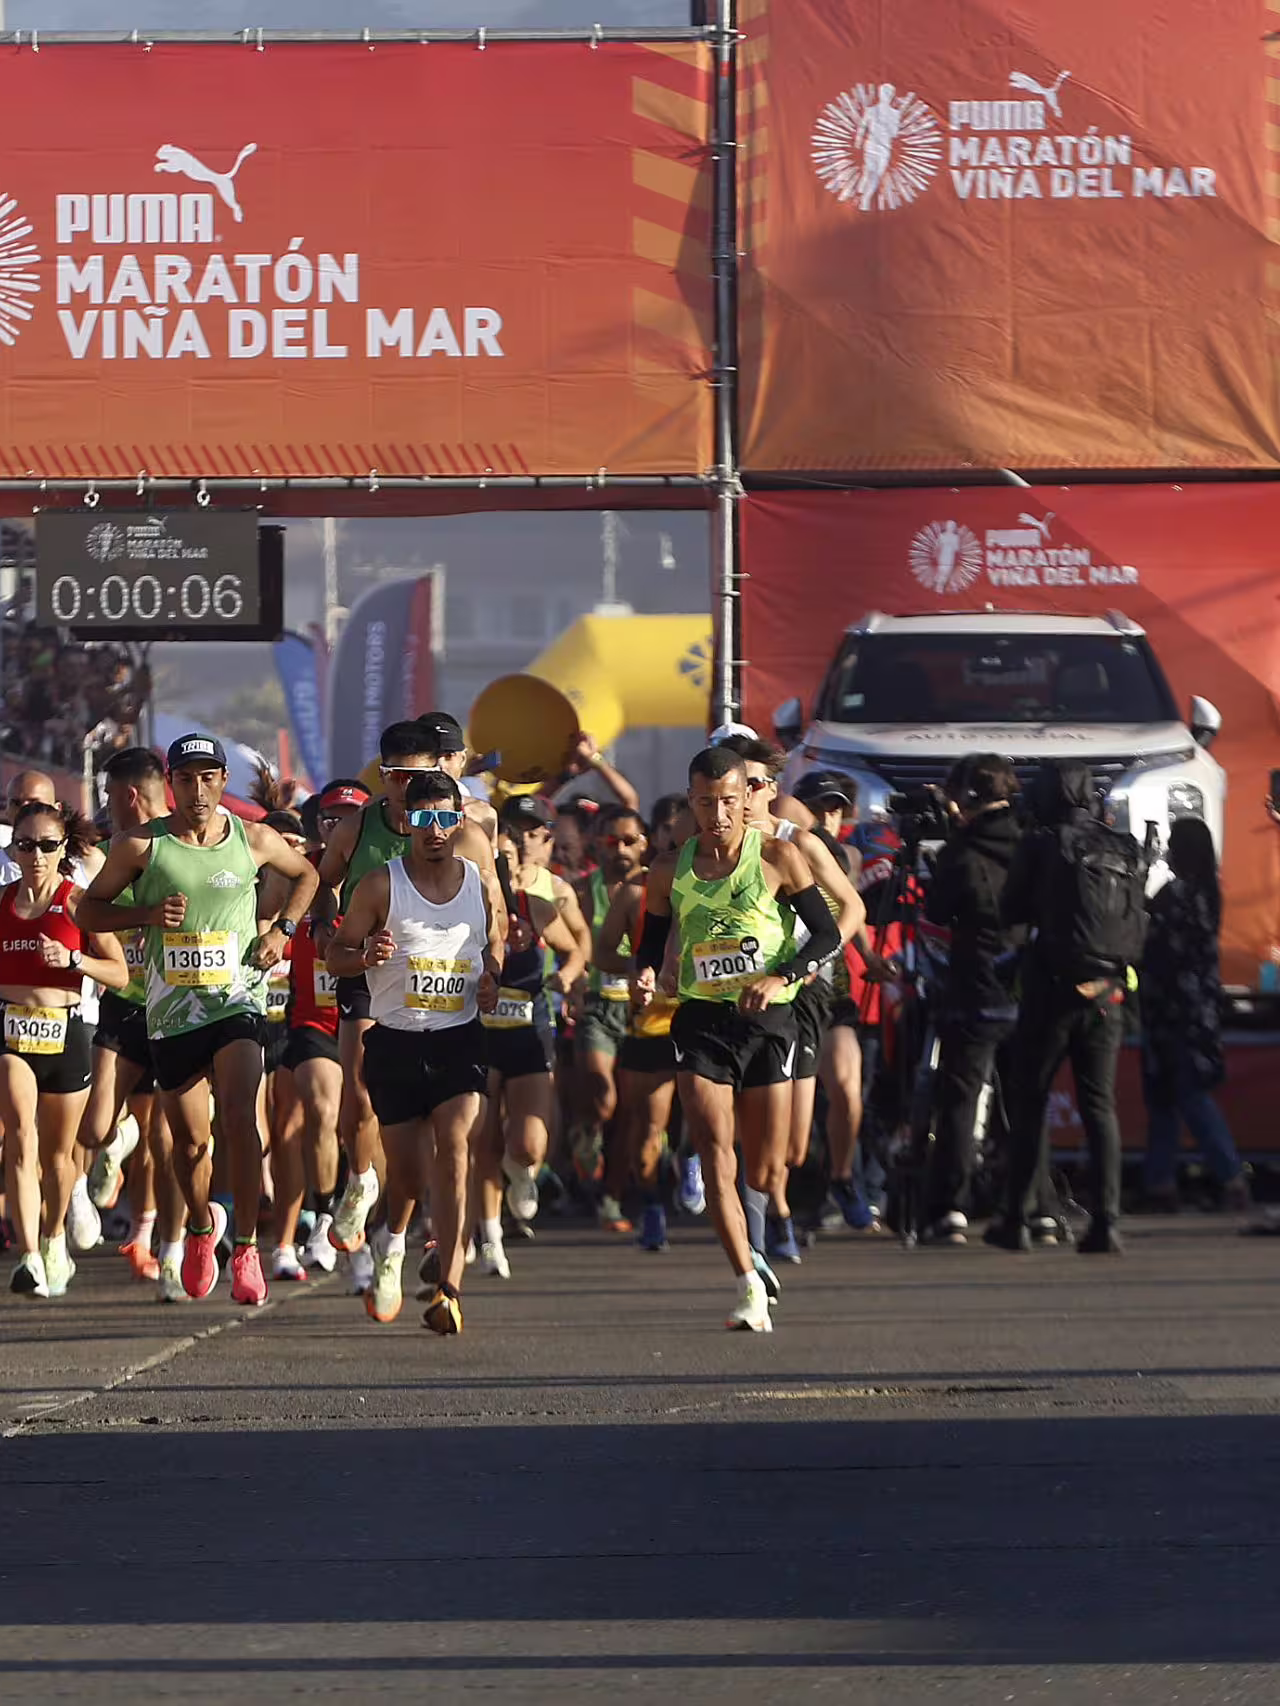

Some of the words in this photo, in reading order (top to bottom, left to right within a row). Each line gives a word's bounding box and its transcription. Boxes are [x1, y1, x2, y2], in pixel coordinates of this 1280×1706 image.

[949, 126, 1132, 167] MARATÓN
[951, 166, 1042, 200] VIÑA
[1050, 169, 1124, 198] DEL
[1132, 167, 1218, 198] MAR
[55, 193, 216, 243] PUMA
[55, 237, 360, 304] MARATÓN
[56, 304, 212, 359] VIÑA
[226, 309, 348, 359] DEL
[365, 307, 505, 358] MAR
[986, 543, 1091, 568] MARATÓN
[1043, 566, 1087, 586] DEL
[1088, 566, 1139, 585] MAR
[51, 574, 243, 620] 0:00:06
[3, 939, 41, 952] EJERCI
[168, 949, 226, 968] 13053
[410, 974, 464, 993] 12000
[8, 1018, 62, 1039] 13058
